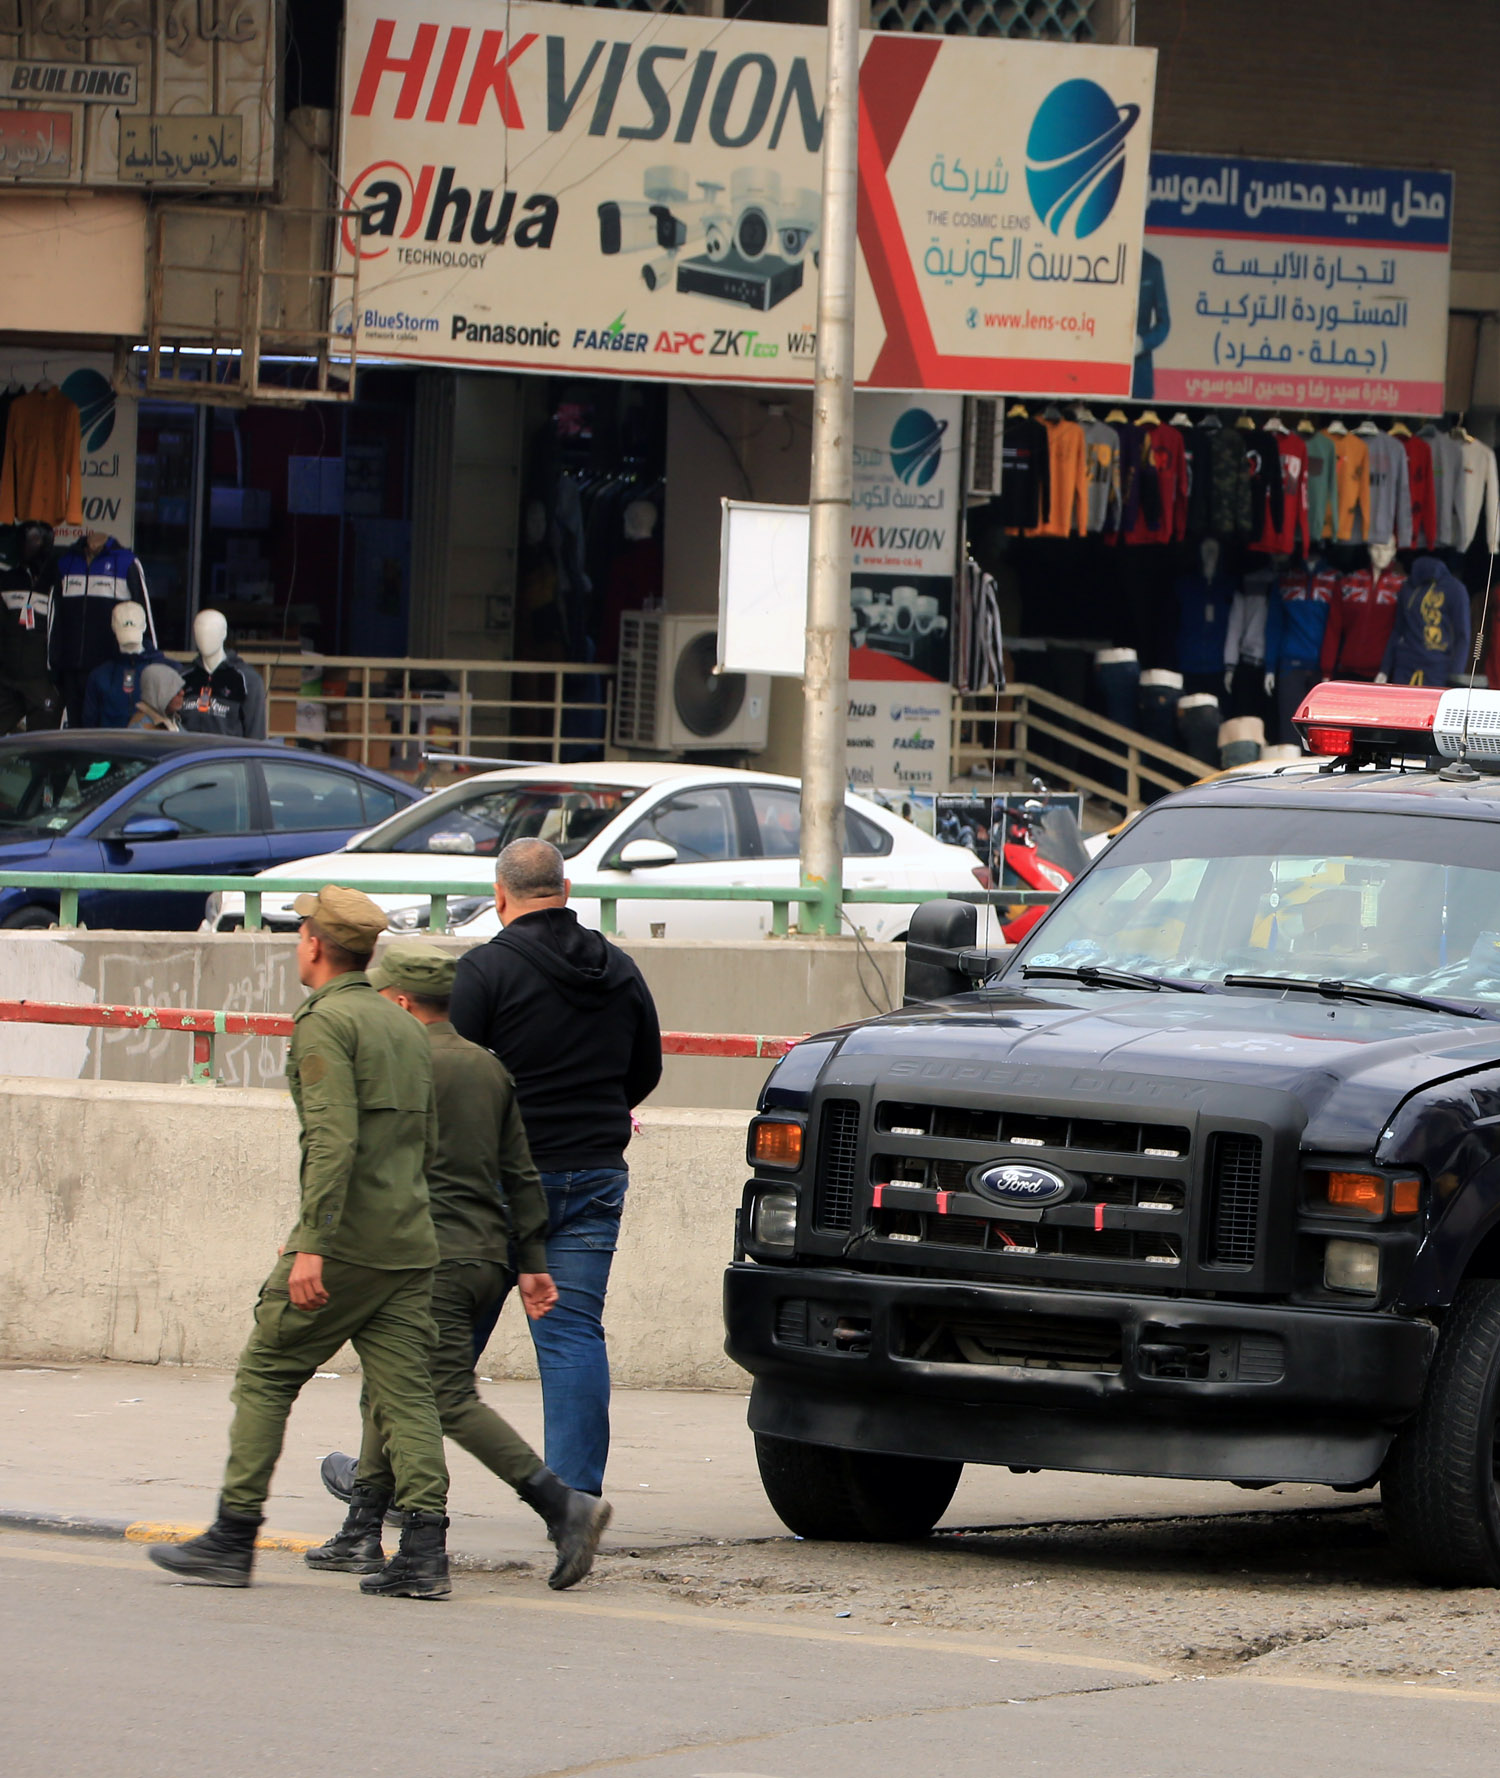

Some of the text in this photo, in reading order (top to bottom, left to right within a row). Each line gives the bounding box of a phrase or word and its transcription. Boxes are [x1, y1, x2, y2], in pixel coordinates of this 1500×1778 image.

[11, 66, 131, 96] BUILDING
[351, 18, 825, 153] HIKVISION
[930, 154, 1009, 201] شركة
[1244, 179, 1327, 219] محسن
[1332, 185, 1387, 225] سيد
[1391, 179, 1446, 228] محل
[927, 210, 1031, 230] THE COSMIC LENS
[398, 247, 486, 268] TECHNOLOGY
[924, 237, 1126, 287] العدسة الكونية
[1313, 256, 1396, 291] لتجارة
[365, 310, 439, 331] BlueStorm
[984, 309, 1095, 336] www.lens-co.iq
[1196, 291, 1408, 332] المستوردة التركية
[452, 315, 560, 349] Panasonic
[573, 327, 648, 353] FARBER
[654, 331, 705, 356] APC
[997, 1167, 1045, 1195] Ford
